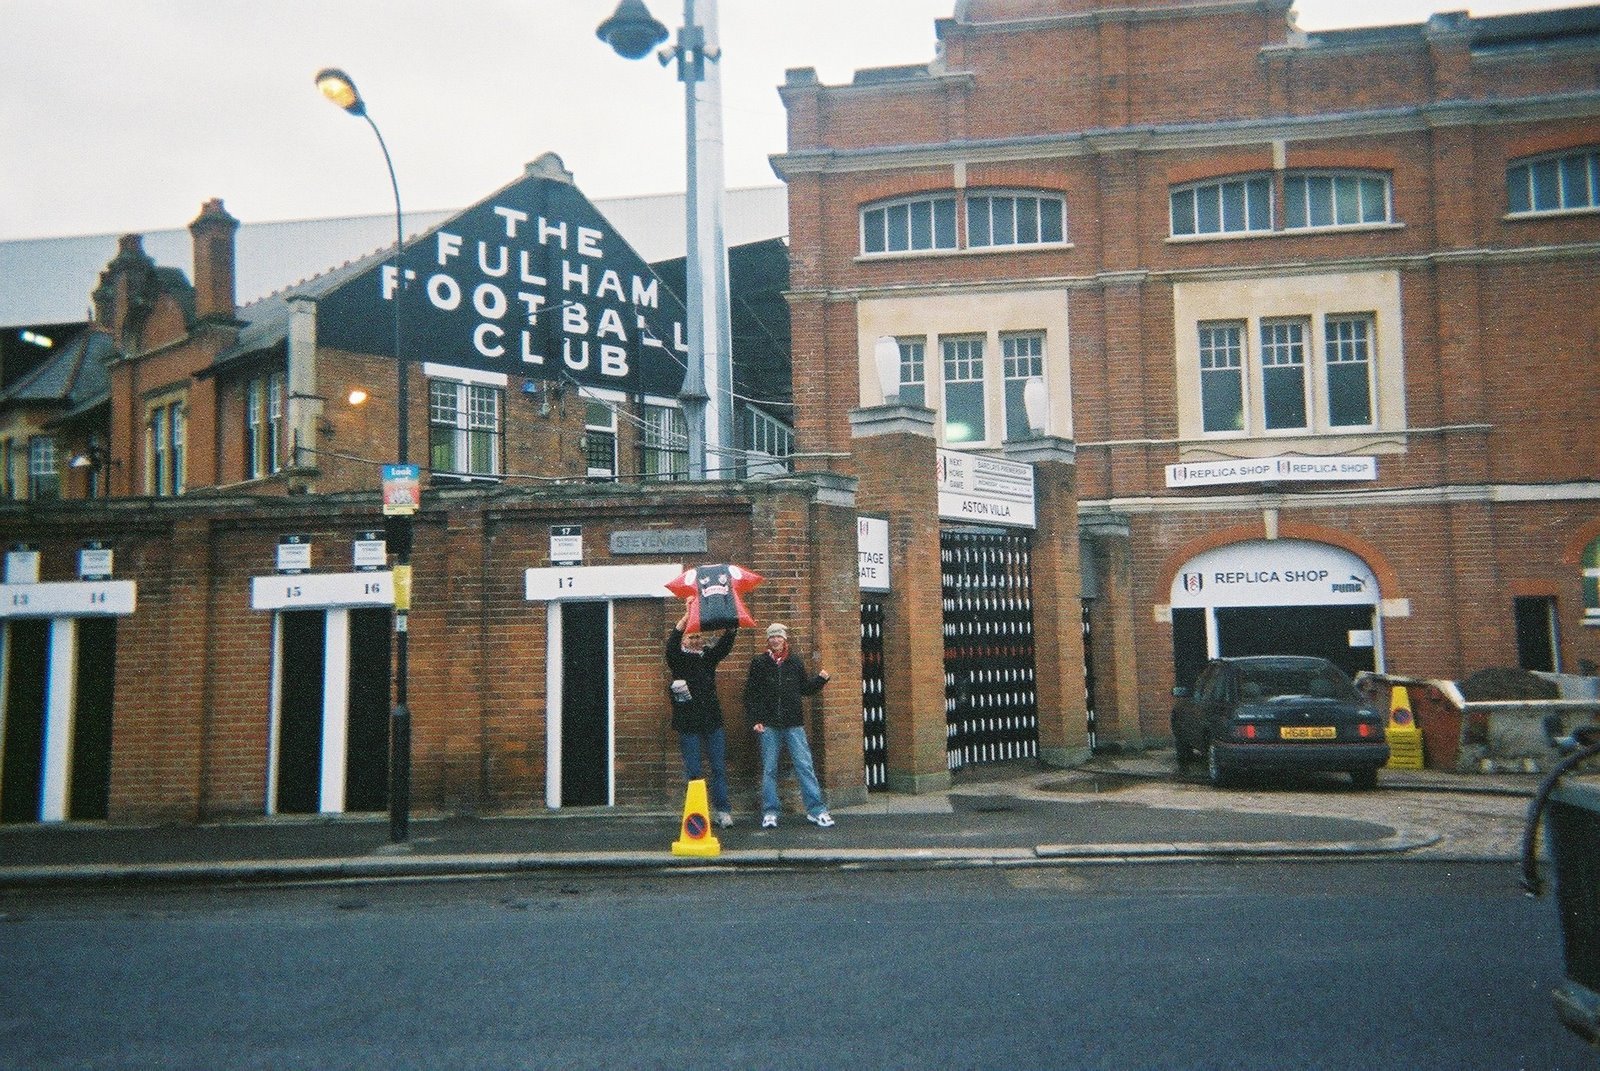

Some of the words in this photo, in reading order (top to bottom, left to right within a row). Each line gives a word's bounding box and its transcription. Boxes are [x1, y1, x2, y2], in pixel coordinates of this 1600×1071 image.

[494, 206, 603, 258] THE
[437, 232, 659, 309] FULHAM
[382, 265, 689, 351] FOOTBALL
[473, 322, 629, 377] CLUB
[1190, 469, 1236, 478] REPLICA
[1240, 465, 1270, 475] SHOP
[1293, 464, 1337, 473] REPLICA
[1341, 464, 1368, 473] SHOP
[962, 501, 988, 514] ASTON
[989, 504, 1011, 517] VILLA
[561, 527, 571, 535] 17
[858, 551, 884, 564] TTAGE
[860, 567, 876, 579] ATE
[1215, 572, 1280, 583] REPLICA
[1285, 570, 1328, 582] SHOP
[364, 583, 380, 594] 16
[558, 577, 573, 588] 17
[1331, 583, 1361, 592] PUMA
[286, 586, 301, 598] 15
